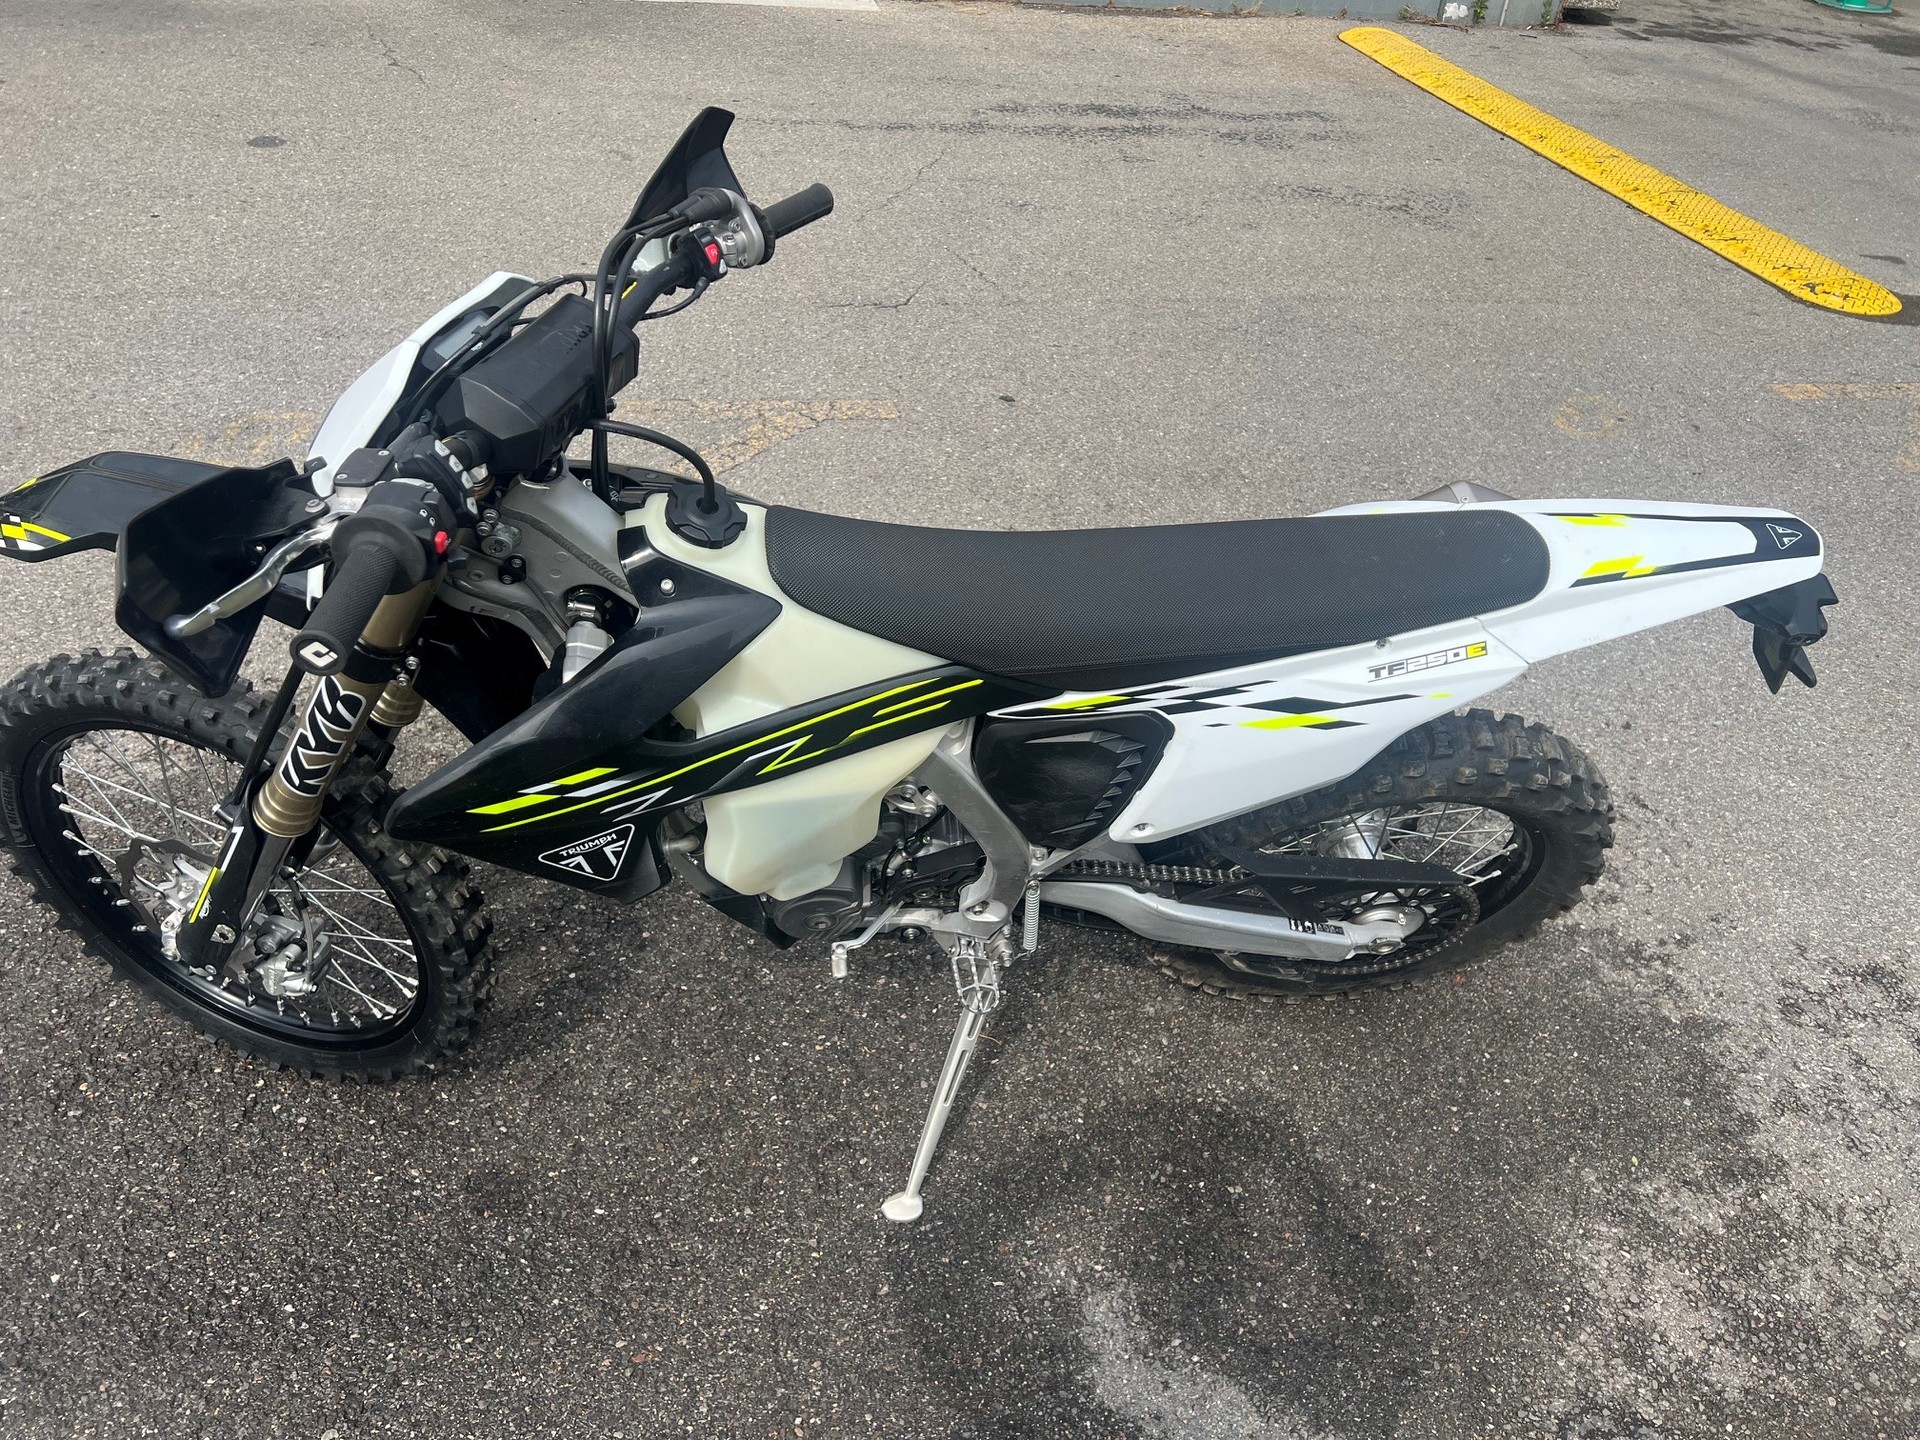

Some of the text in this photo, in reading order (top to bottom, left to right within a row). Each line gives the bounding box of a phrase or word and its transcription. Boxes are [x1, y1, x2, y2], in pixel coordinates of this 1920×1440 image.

[1368, 641, 1488, 679] TF250E
[279, 675, 367, 798] KYB
[558, 832, 618, 857] TRIUMPH
